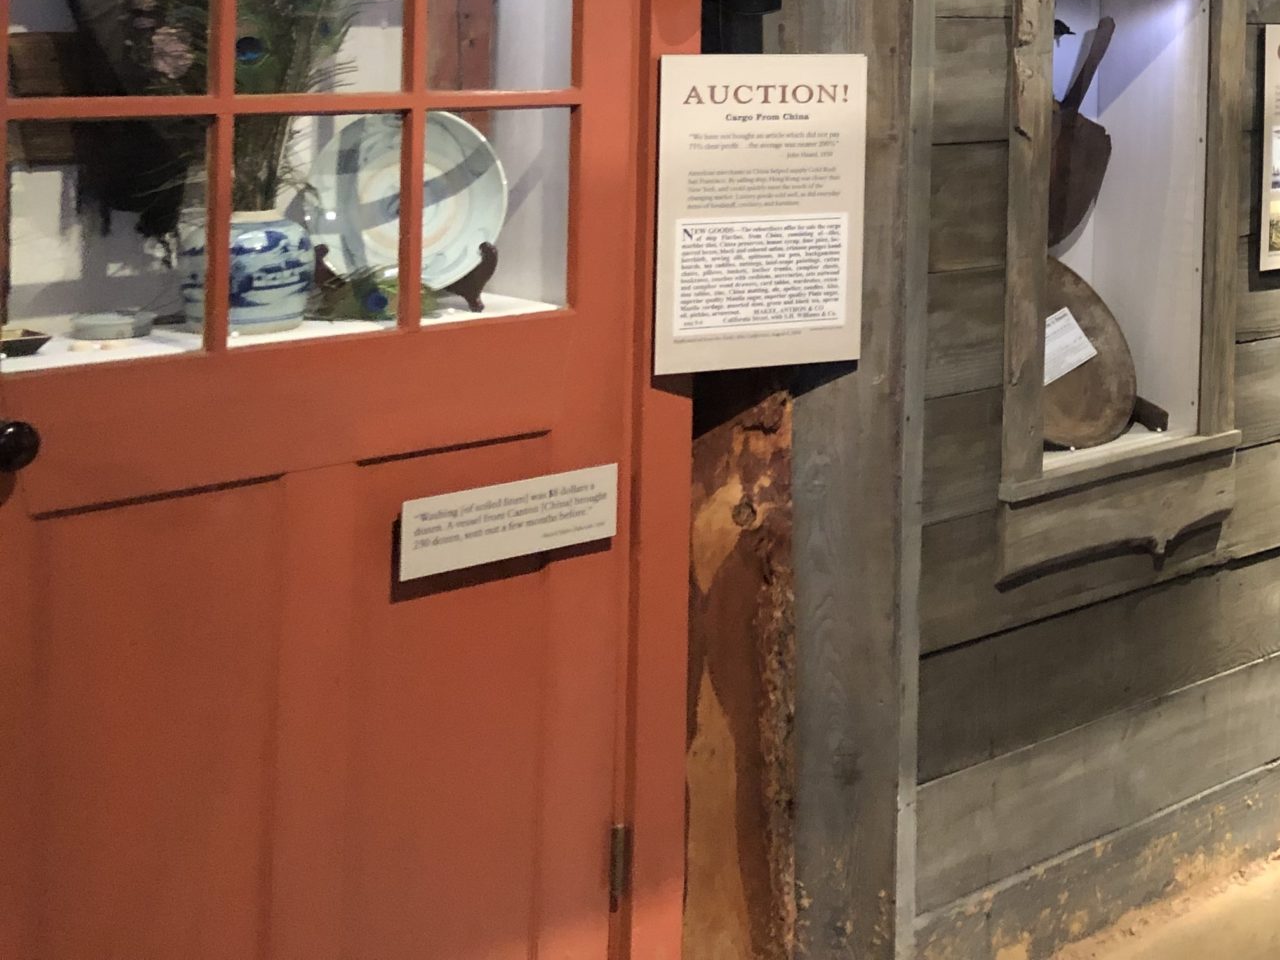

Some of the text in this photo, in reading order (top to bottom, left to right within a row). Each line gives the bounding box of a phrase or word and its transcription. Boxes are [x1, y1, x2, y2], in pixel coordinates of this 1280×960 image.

[683, 84, 849, 105] AUCTION!
[726, 113, 810, 122] Cargo From China
[531, 492, 547, 501] was
[560, 482, 588, 495] dollars
[484, 510, 505, 522] from
[508, 504, 538, 518] Canton
[575, 490, 607, 507] brought
[508, 520, 523, 531] few
[526, 513, 558, 527] months
